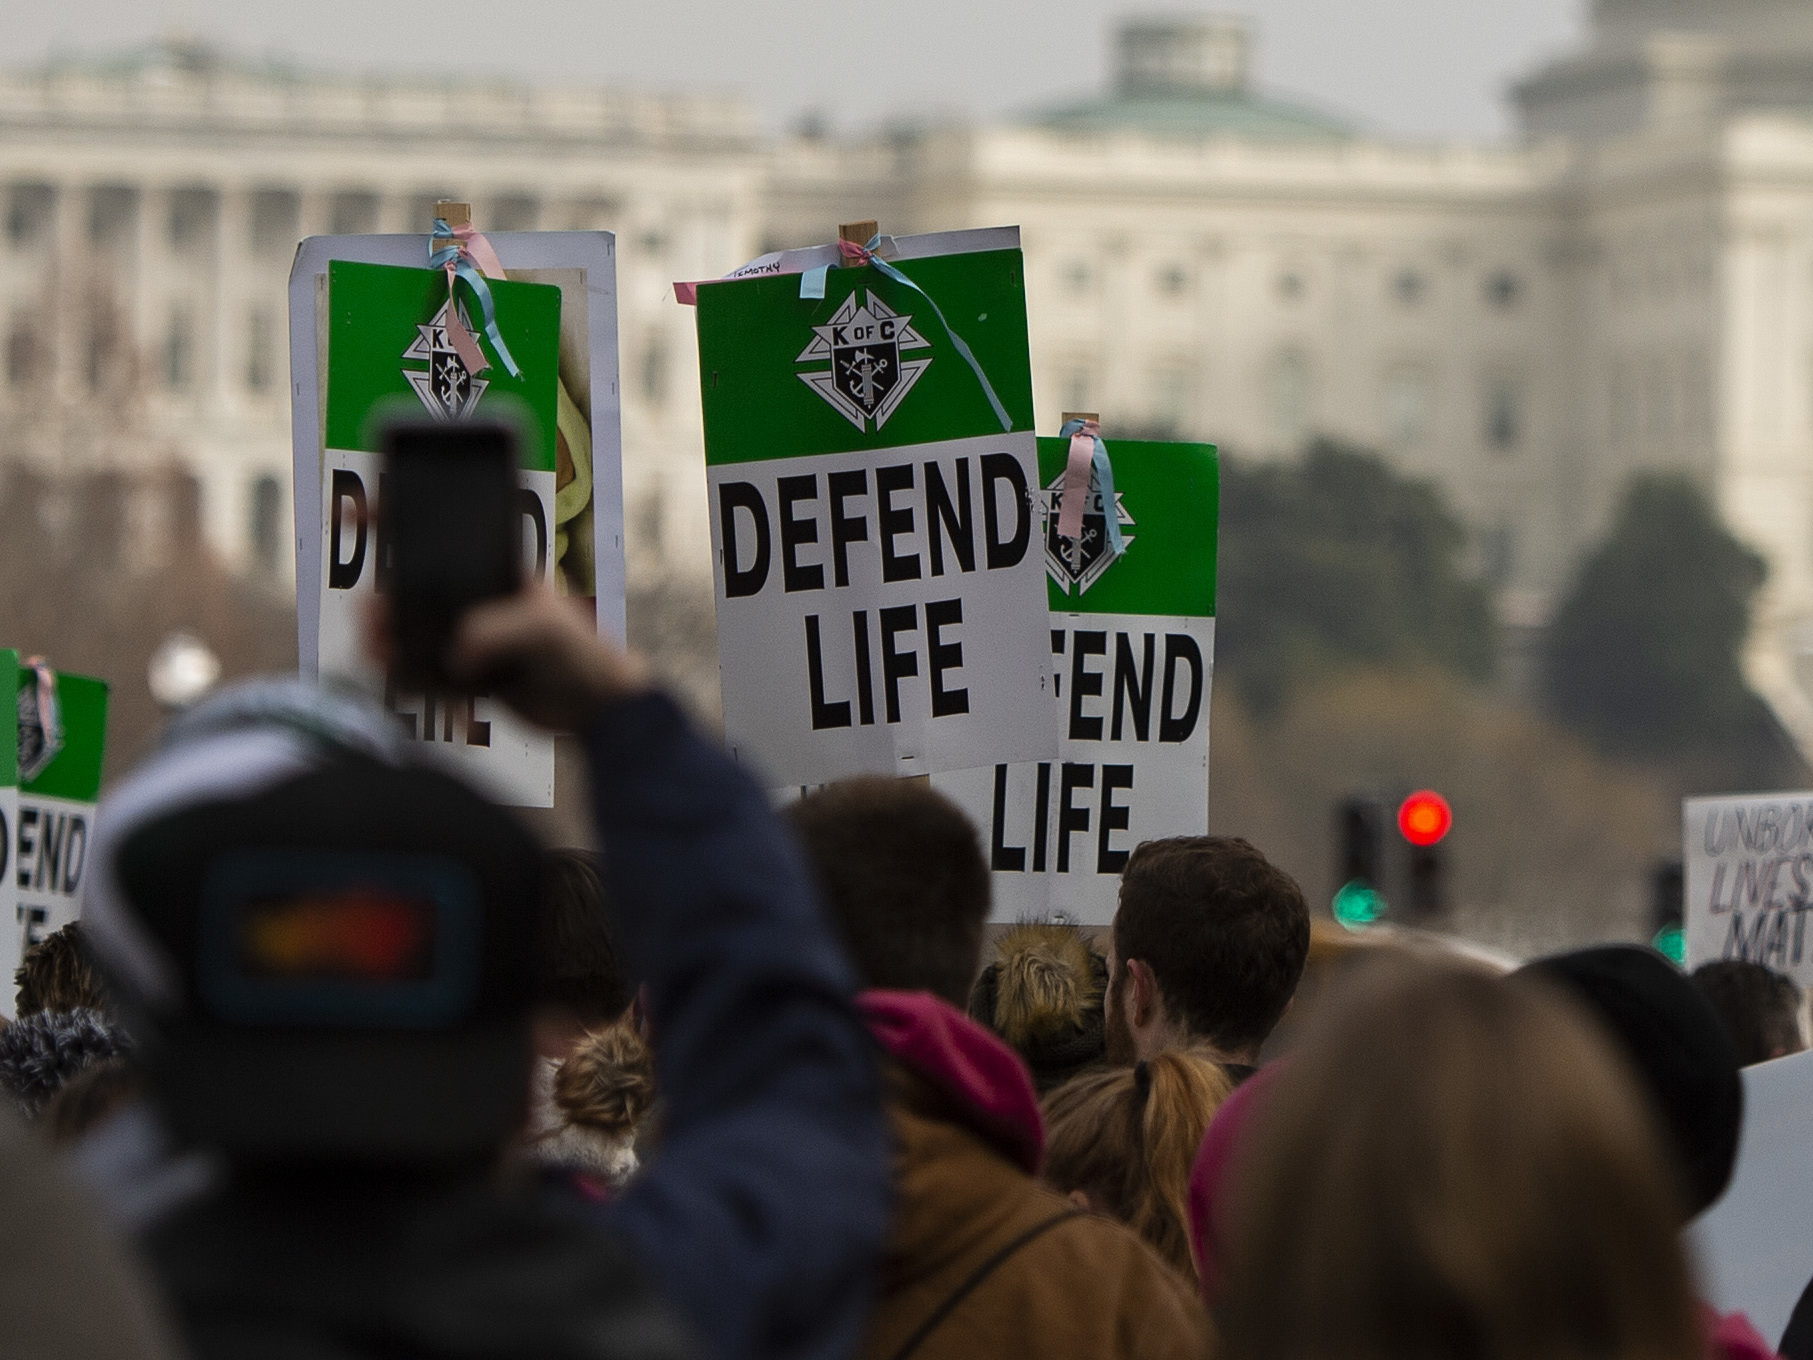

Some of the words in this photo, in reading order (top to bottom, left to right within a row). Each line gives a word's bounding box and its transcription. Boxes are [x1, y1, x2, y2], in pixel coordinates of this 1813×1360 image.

[833, 326, 849, 345] K
[854, 325, 874, 340] OF
[880, 320, 895, 340] C
[719, 452, 1031, 598] DEFEND
[805, 597, 970, 730] LIFE
[991, 762, 1133, 874] LIFE
